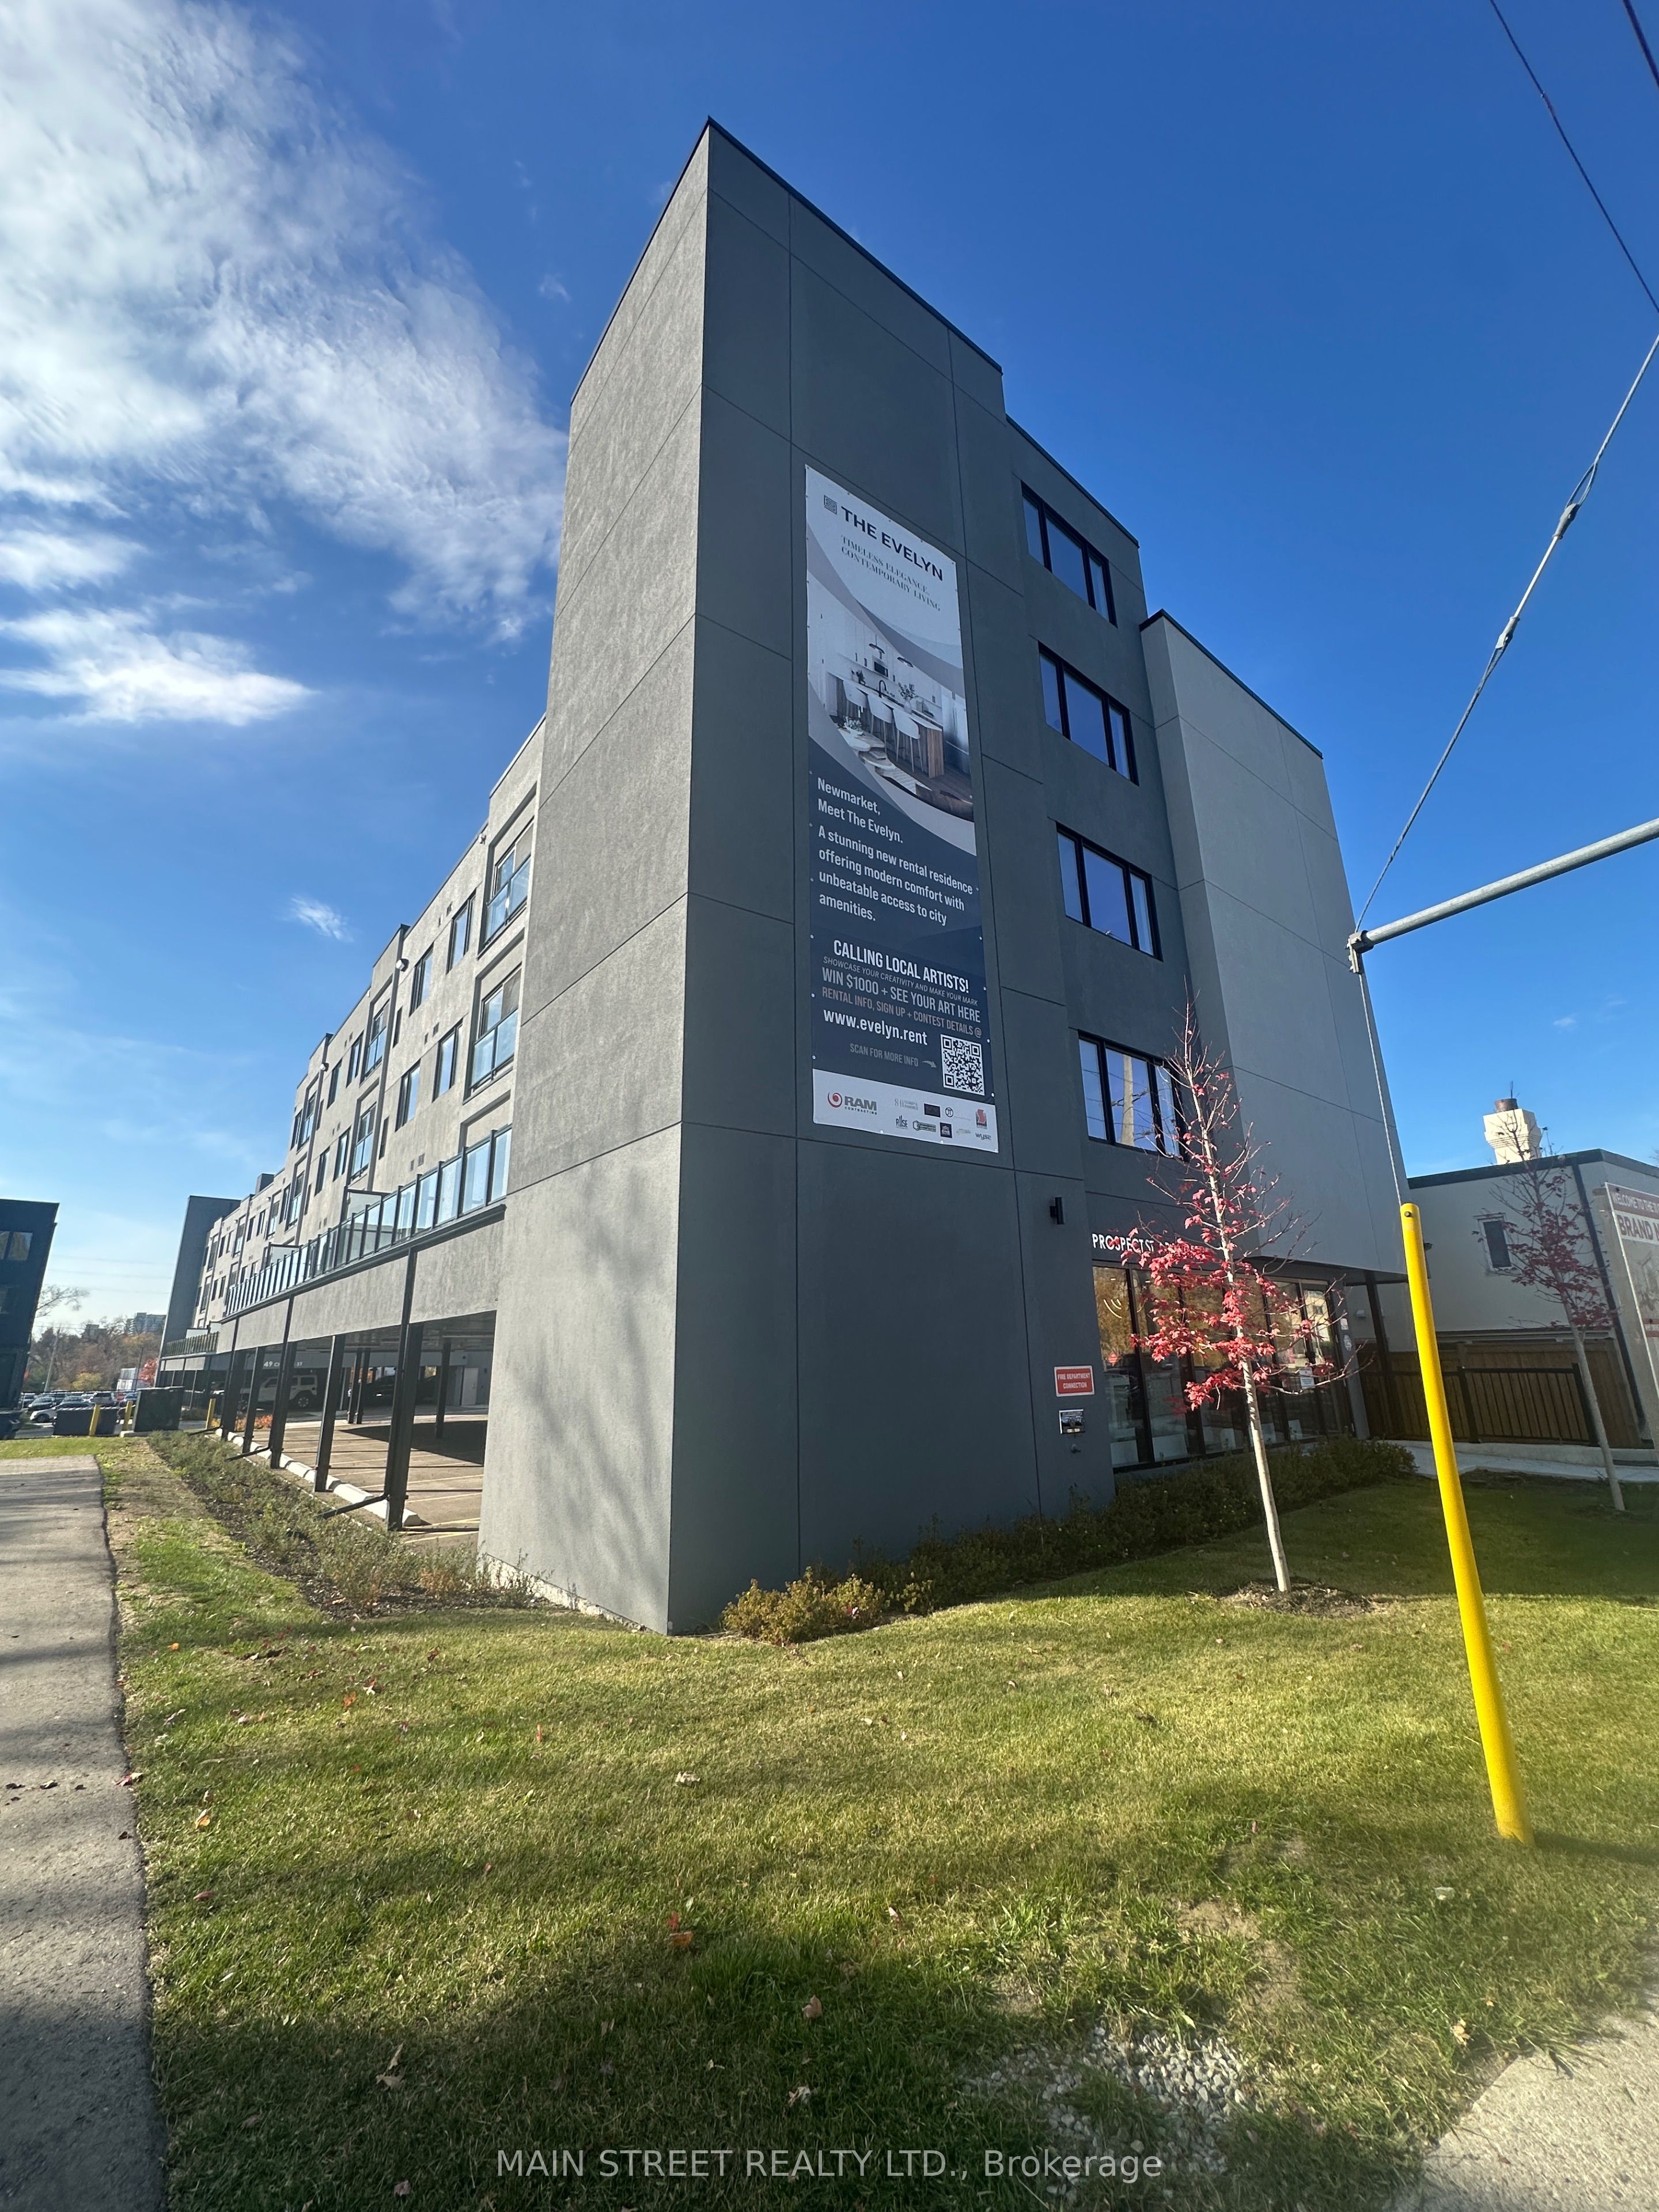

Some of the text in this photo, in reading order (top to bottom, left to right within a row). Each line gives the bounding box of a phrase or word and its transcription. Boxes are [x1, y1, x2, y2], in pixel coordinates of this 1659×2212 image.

[841, 506, 943, 581] THE EVELYN
[841, 535, 884, 566] TIMELESS
[842, 546, 911, 593] CONTEMPORARY
[817, 777, 881, 816] Newmarket,
[817, 798, 903, 843] Meet The Evelyn.
[818, 825, 973, 895] A stunning new rental residence
[819, 849, 965, 911] offering modern comfort with
[819, 871, 947, 926] unbeatable access to city
[819, 893, 876, 921] amenities.
[823, 956, 978, 1006] SHOWCASE YOUR CREATIVITY AND MAKE YOUR MARK
[834, 940, 969, 994] CALLING LOCAL ARTISTS!
[822, 967, 981, 1023] WIN $1000 + SEE YOUR ART HERE
[822, 986, 853, 1005] RENTAL
[855, 995, 874, 1011] INFO,
[876, 1001, 894, 1015] SIGN
[896, 1006, 906, 1017] UP
[914, 1011, 945, 1028] CONTEST
[946, 1019, 974, 1035] DETAILS
[974, 1027, 982, 1038] @
[823, 1009, 928, 1046] www.evelyn.rent
[850, 1043, 919, 1067] SCAN FOR MORE INFO
[844, 1096, 877, 1111] RAM
[844, 1106, 877, 1115] CONTRACTING
[1092, 1233, 1143, 1253] PROSPECT
[1616, 1214, 1653, 1240] BRAND
